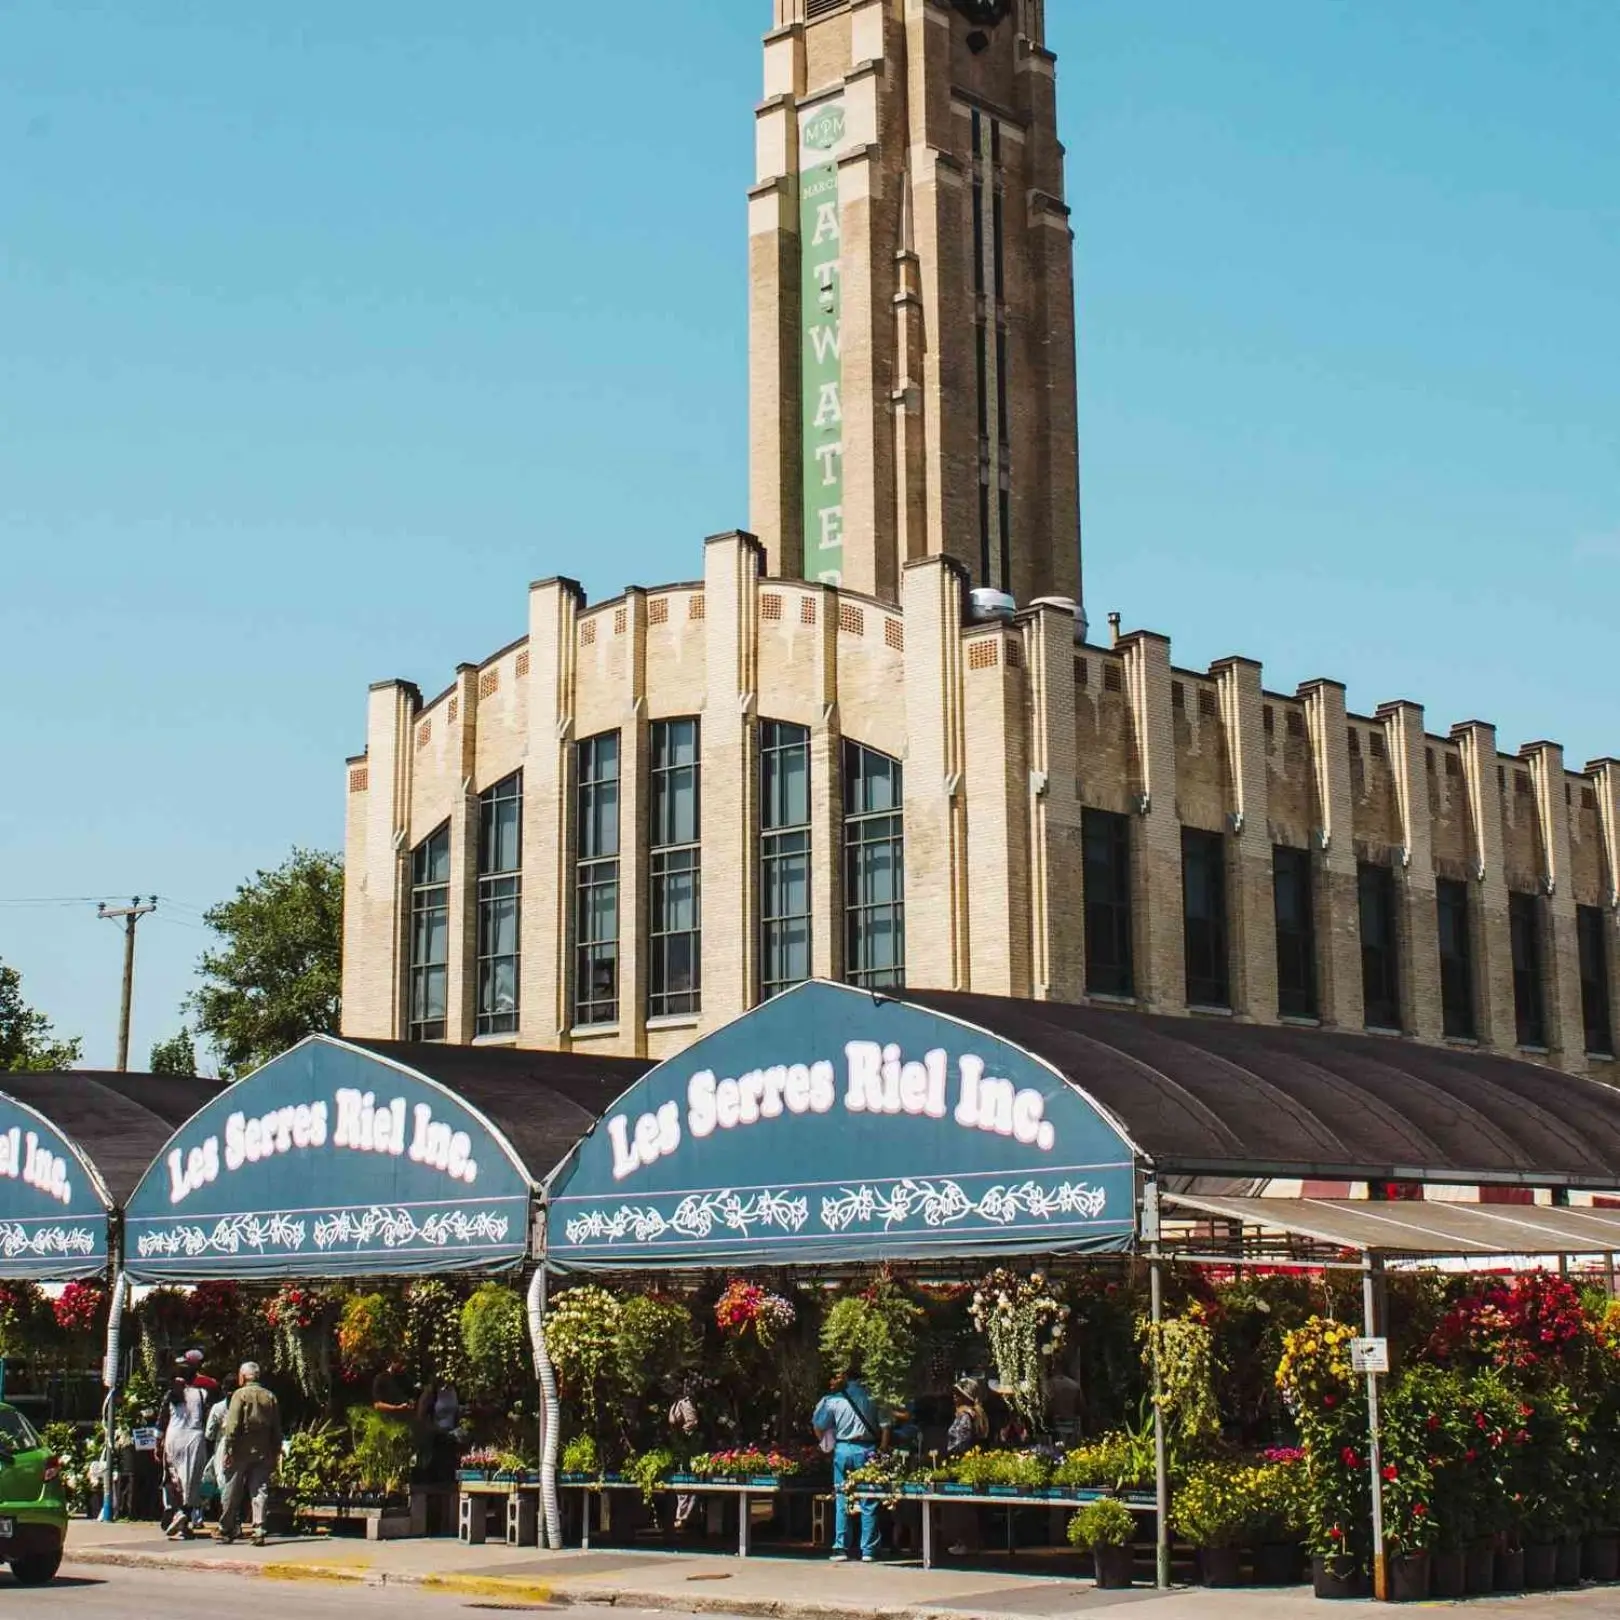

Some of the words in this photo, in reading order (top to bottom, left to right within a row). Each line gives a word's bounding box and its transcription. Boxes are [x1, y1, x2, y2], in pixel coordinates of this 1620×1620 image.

[0, 1126, 21, 1179] el
[23, 1131, 72, 1206] Inc.
[167, 1134, 219, 1204] Les
[224, 1100, 328, 1171] Serres
[333, 1087, 407, 1156] Riel
[408, 1102, 478, 1184] Inc.
[607, 1100, 681, 1180] Les
[687, 1060, 836, 1138] Serres
[843, 1040, 948, 1118] Riel
[954, 1053, 1056, 1151] Inc.
